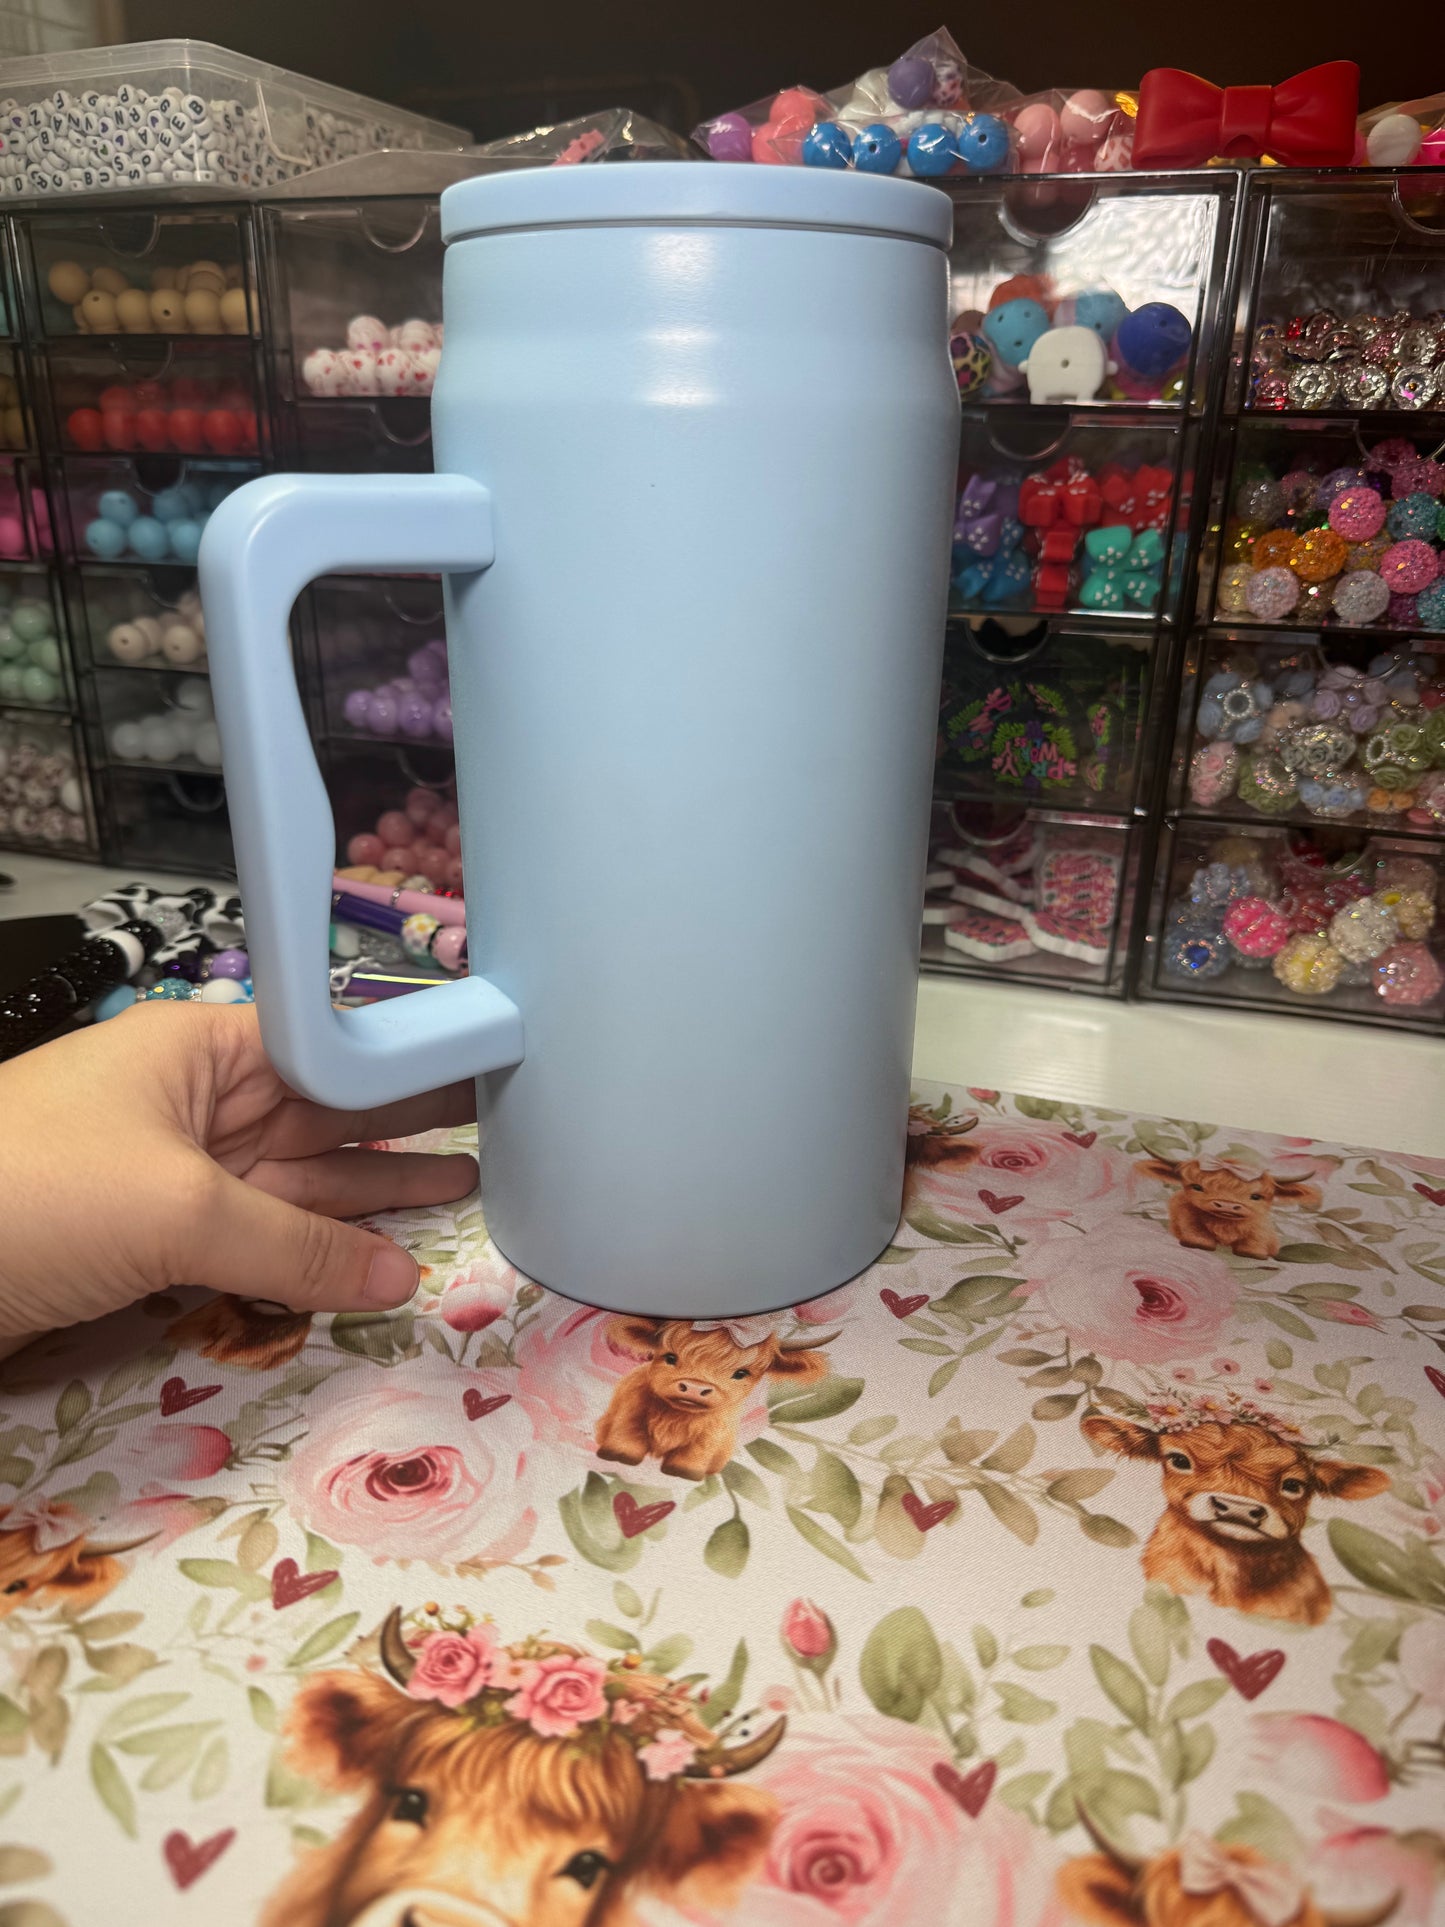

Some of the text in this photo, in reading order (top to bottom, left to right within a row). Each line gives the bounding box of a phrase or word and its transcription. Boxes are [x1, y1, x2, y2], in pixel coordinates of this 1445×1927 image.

[189, 101, 203, 115] B
[172, 116, 185, 131] E
[160, 133, 171, 147] E
[85, 172, 92, 185] B
[1000, 757, 1064, 780] PRAY
